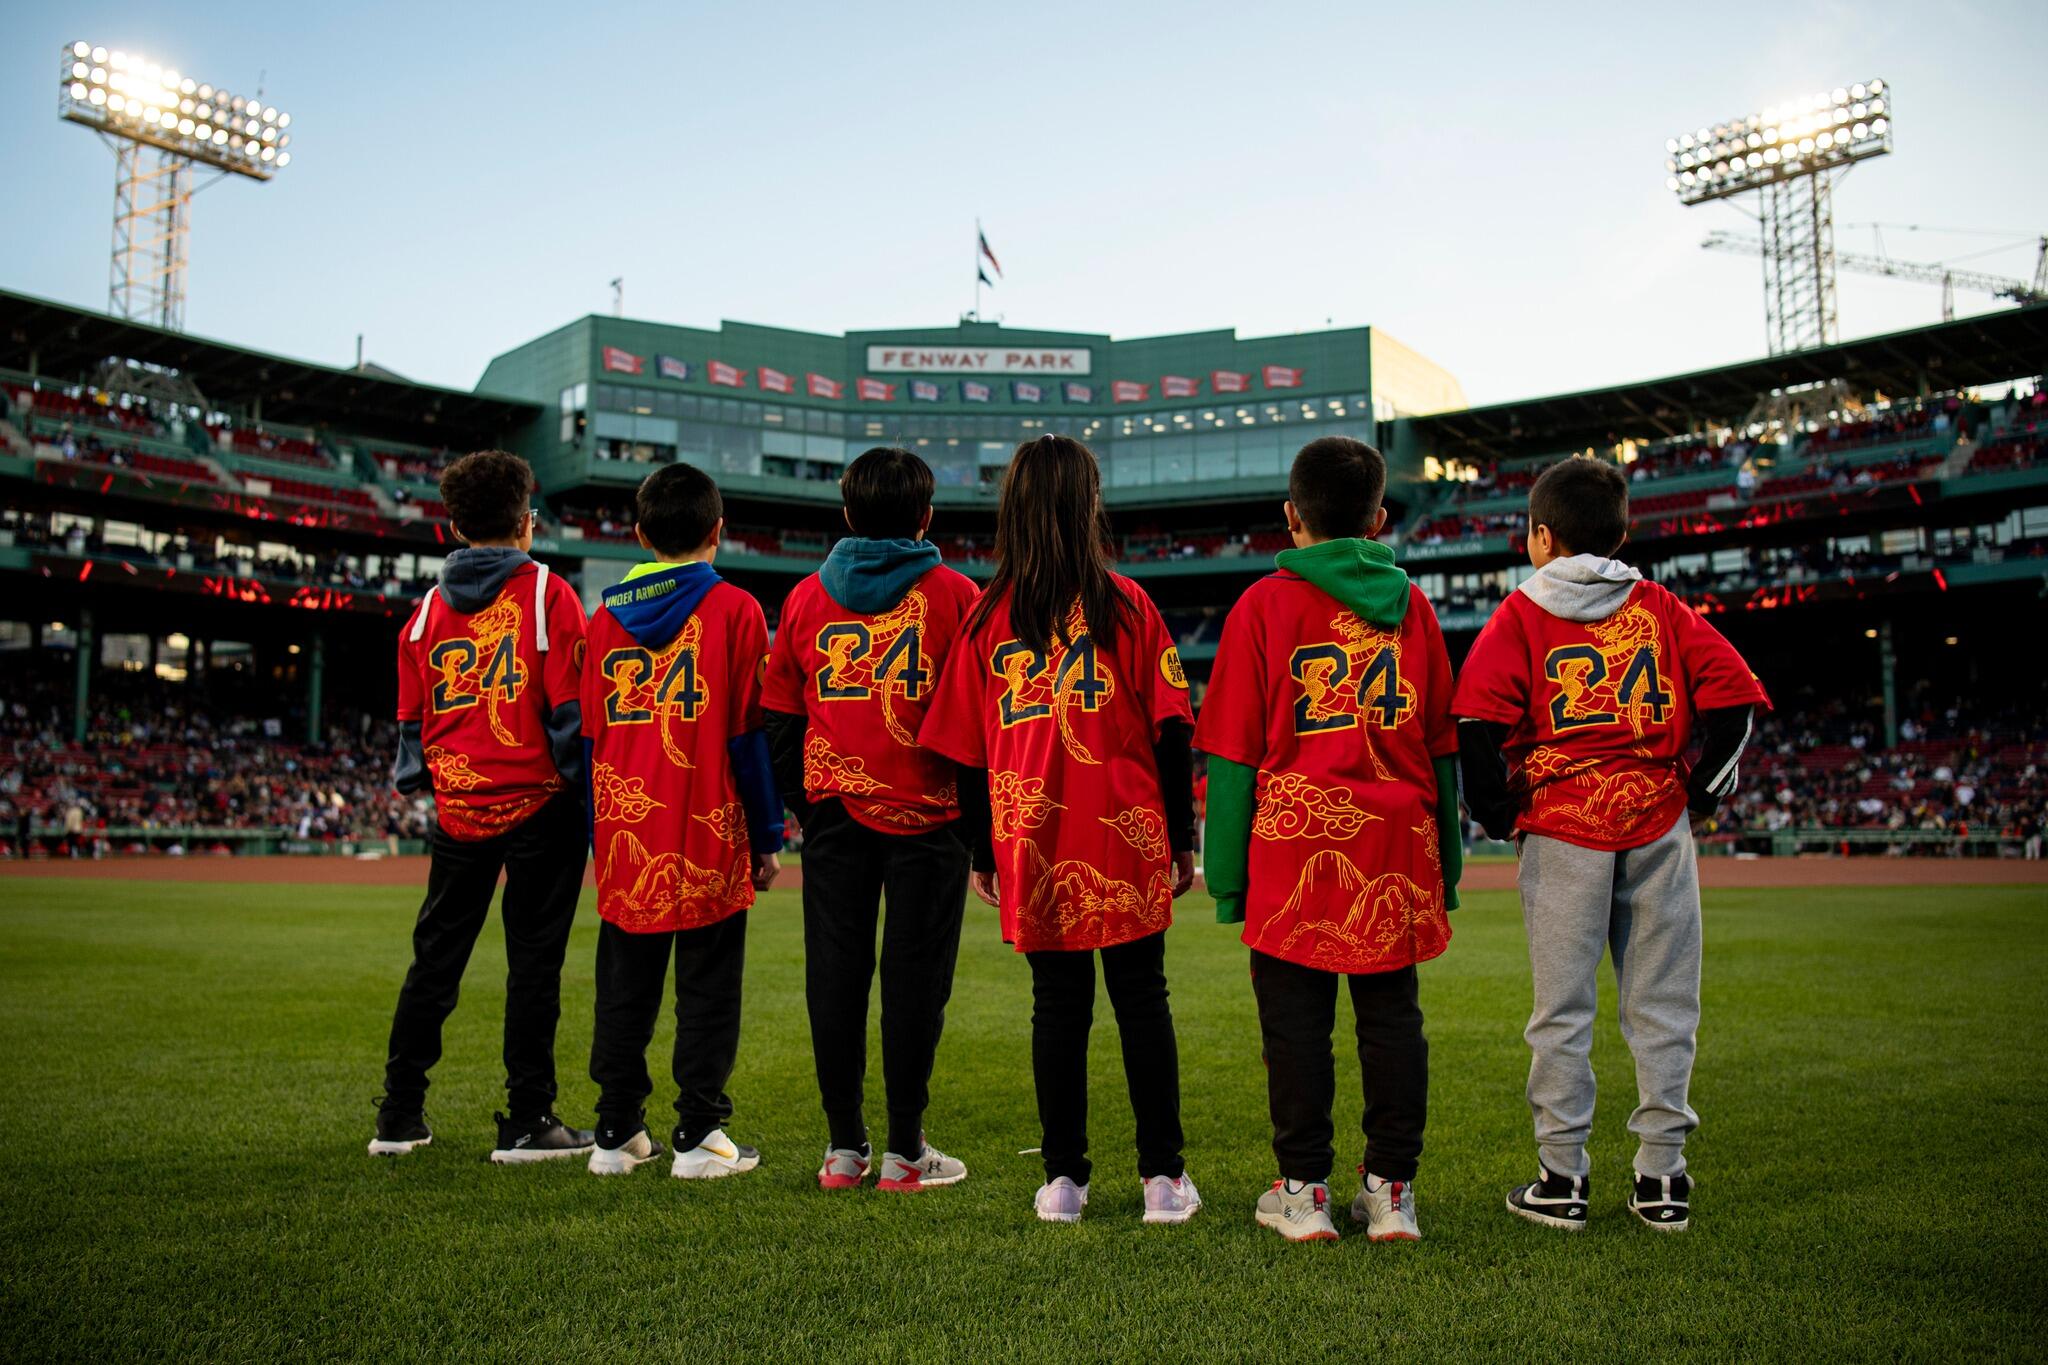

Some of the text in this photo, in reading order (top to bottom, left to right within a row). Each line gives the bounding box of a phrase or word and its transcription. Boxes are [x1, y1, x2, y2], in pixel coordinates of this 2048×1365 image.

[882, 351, 1075, 369] FENWAY PARK
[605, 579, 677, 608] UNDER ARMOUR
[429, 633, 523, 714] 24
[601, 645, 704, 726] 24
[816, 620, 930, 702] 24
[989, 634, 1108, 730] 24
[1289, 641, 1410, 736] 24
[1544, 643, 1673, 735] 24
